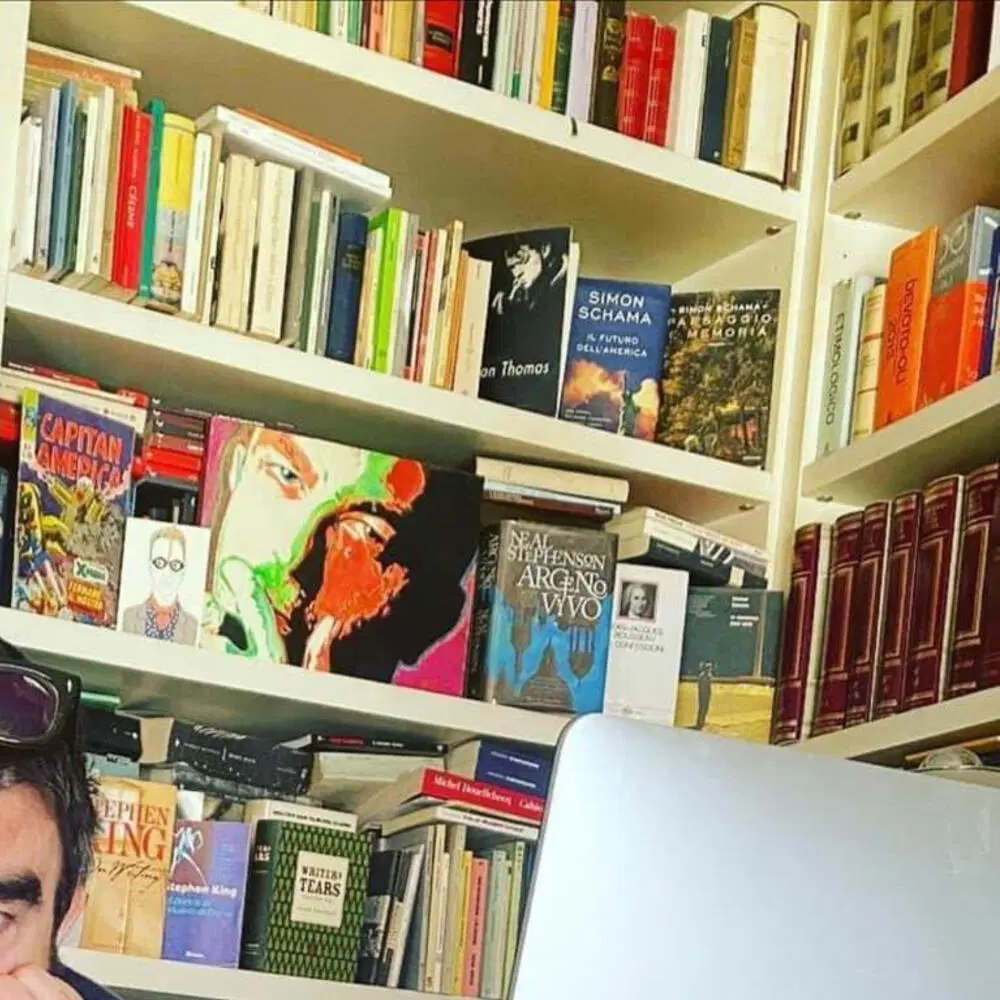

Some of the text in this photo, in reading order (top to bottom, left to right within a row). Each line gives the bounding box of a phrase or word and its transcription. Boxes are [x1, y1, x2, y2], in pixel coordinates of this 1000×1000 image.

[588, 291, 645, 309] SIMON
[578, 306, 652, 326] SCHAMA
[587, 332, 640, 346] IL FUTURO
[576, 343, 648, 359] DELL'AMERICA
[502, 359, 550, 377] Thomas
[41, 412, 124, 464] CAPITAN
[36, 442, 123, 492] AMERICA
[507, 529, 555, 551] NEAL
[507, 543, 607, 572] STEPHENSON
[517, 564, 609, 600] ARGENTO
[541, 591, 603, 622] VIVO
[211, 884, 238, 899] King
[299, 877, 342, 898] TEARS
